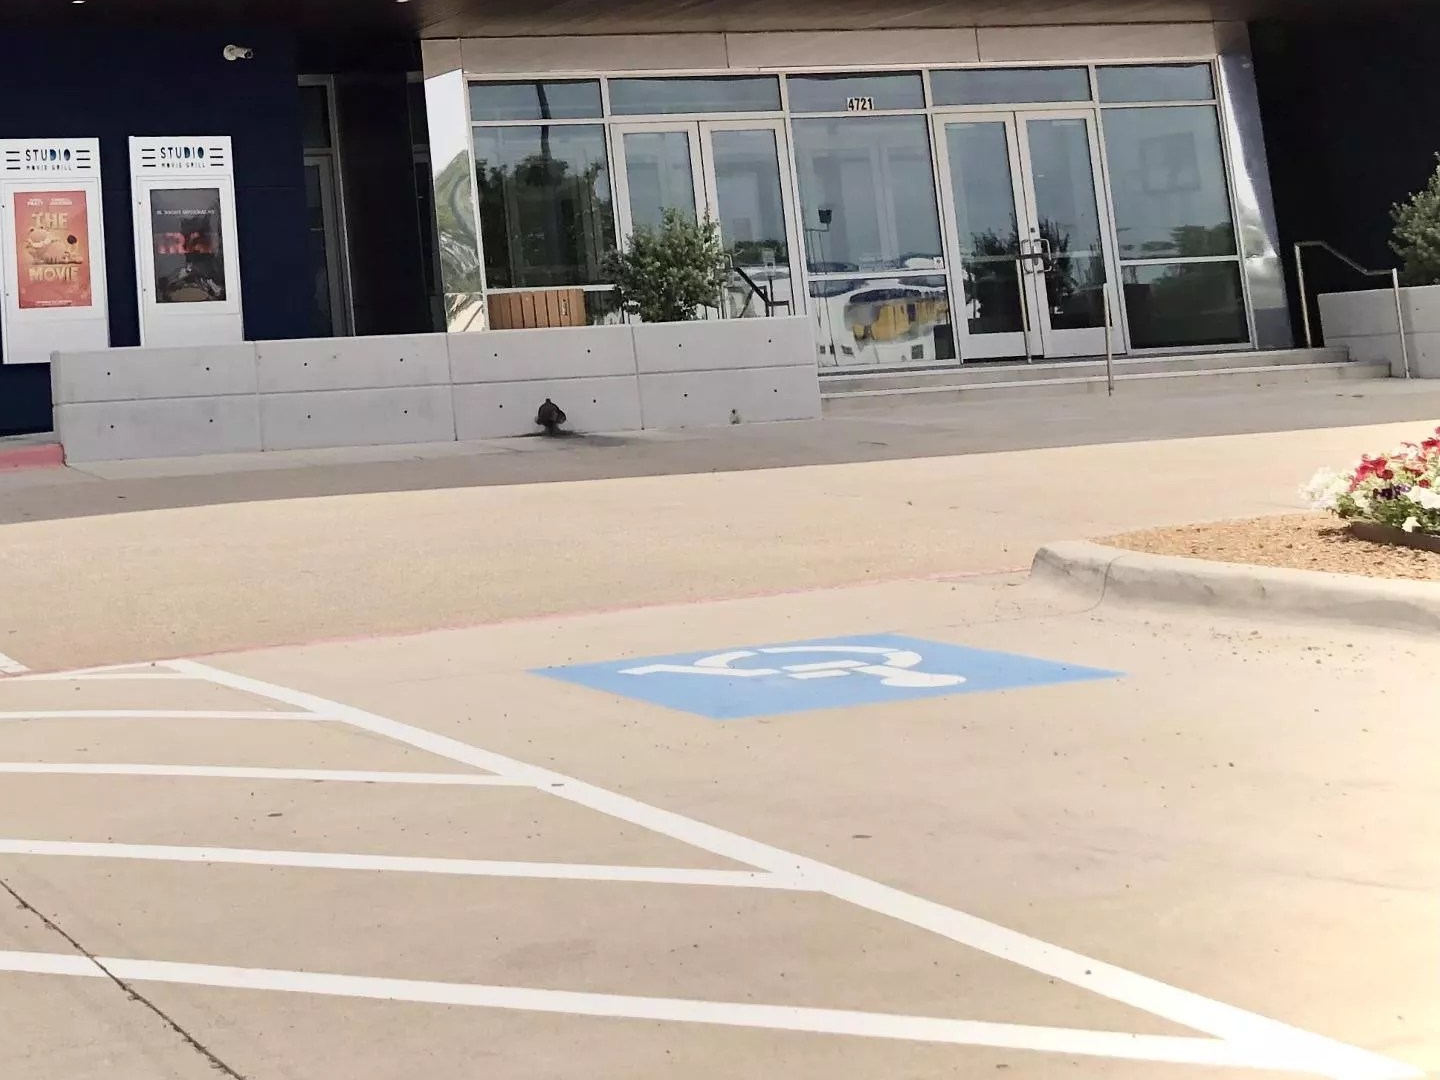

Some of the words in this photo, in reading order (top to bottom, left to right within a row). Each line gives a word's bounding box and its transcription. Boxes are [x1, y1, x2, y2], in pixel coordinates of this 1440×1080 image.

[848, 97, 873, 110] 4721
[25, 148, 71, 161] STUDIO
[160, 146, 204, 159] STUDIO
[32, 212, 68, 228] THE
[28, 266, 80, 281] MOVIE
